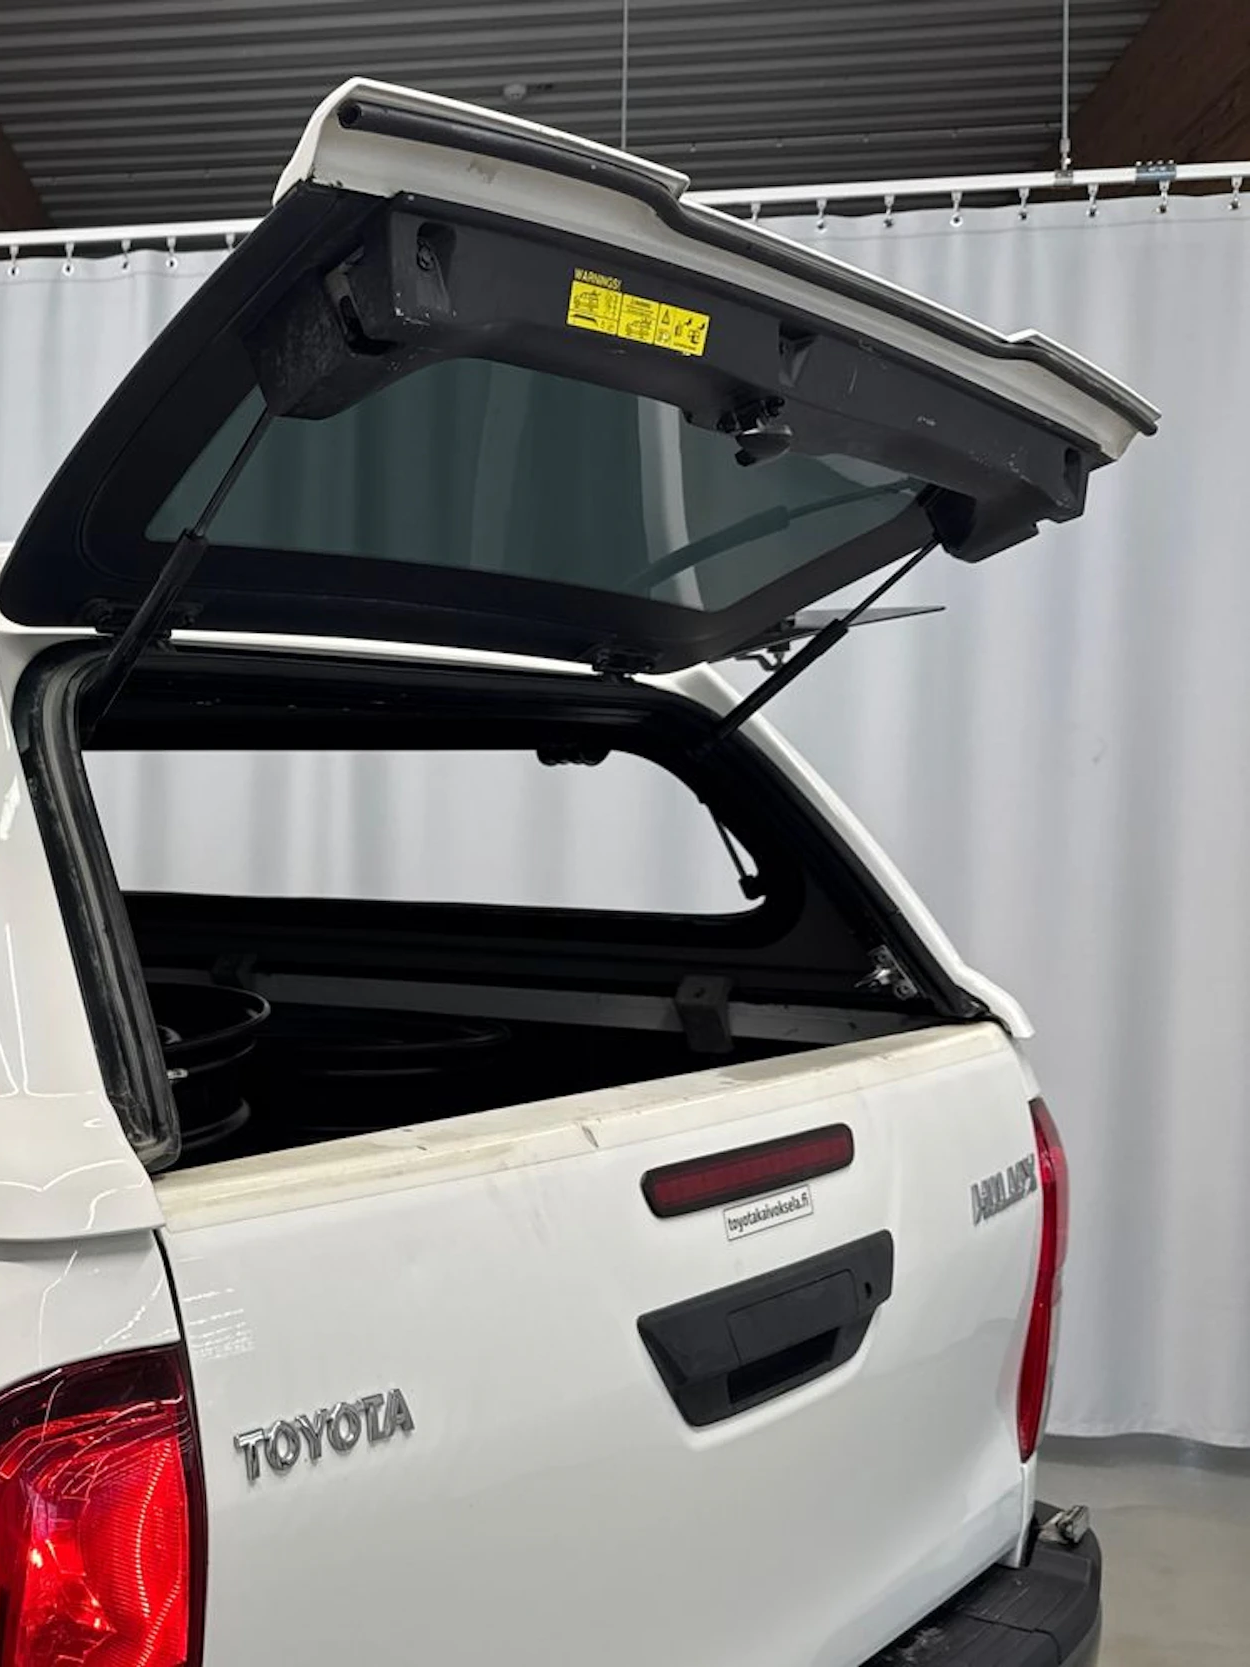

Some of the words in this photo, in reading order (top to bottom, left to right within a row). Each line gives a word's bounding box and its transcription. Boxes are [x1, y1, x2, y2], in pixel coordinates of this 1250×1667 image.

[574, 268, 622, 291] WARNINGS!
[728, 1192, 809, 1232] toyotakaivoksela.fi
[234, 1388, 415, 1480] TOYOTA
